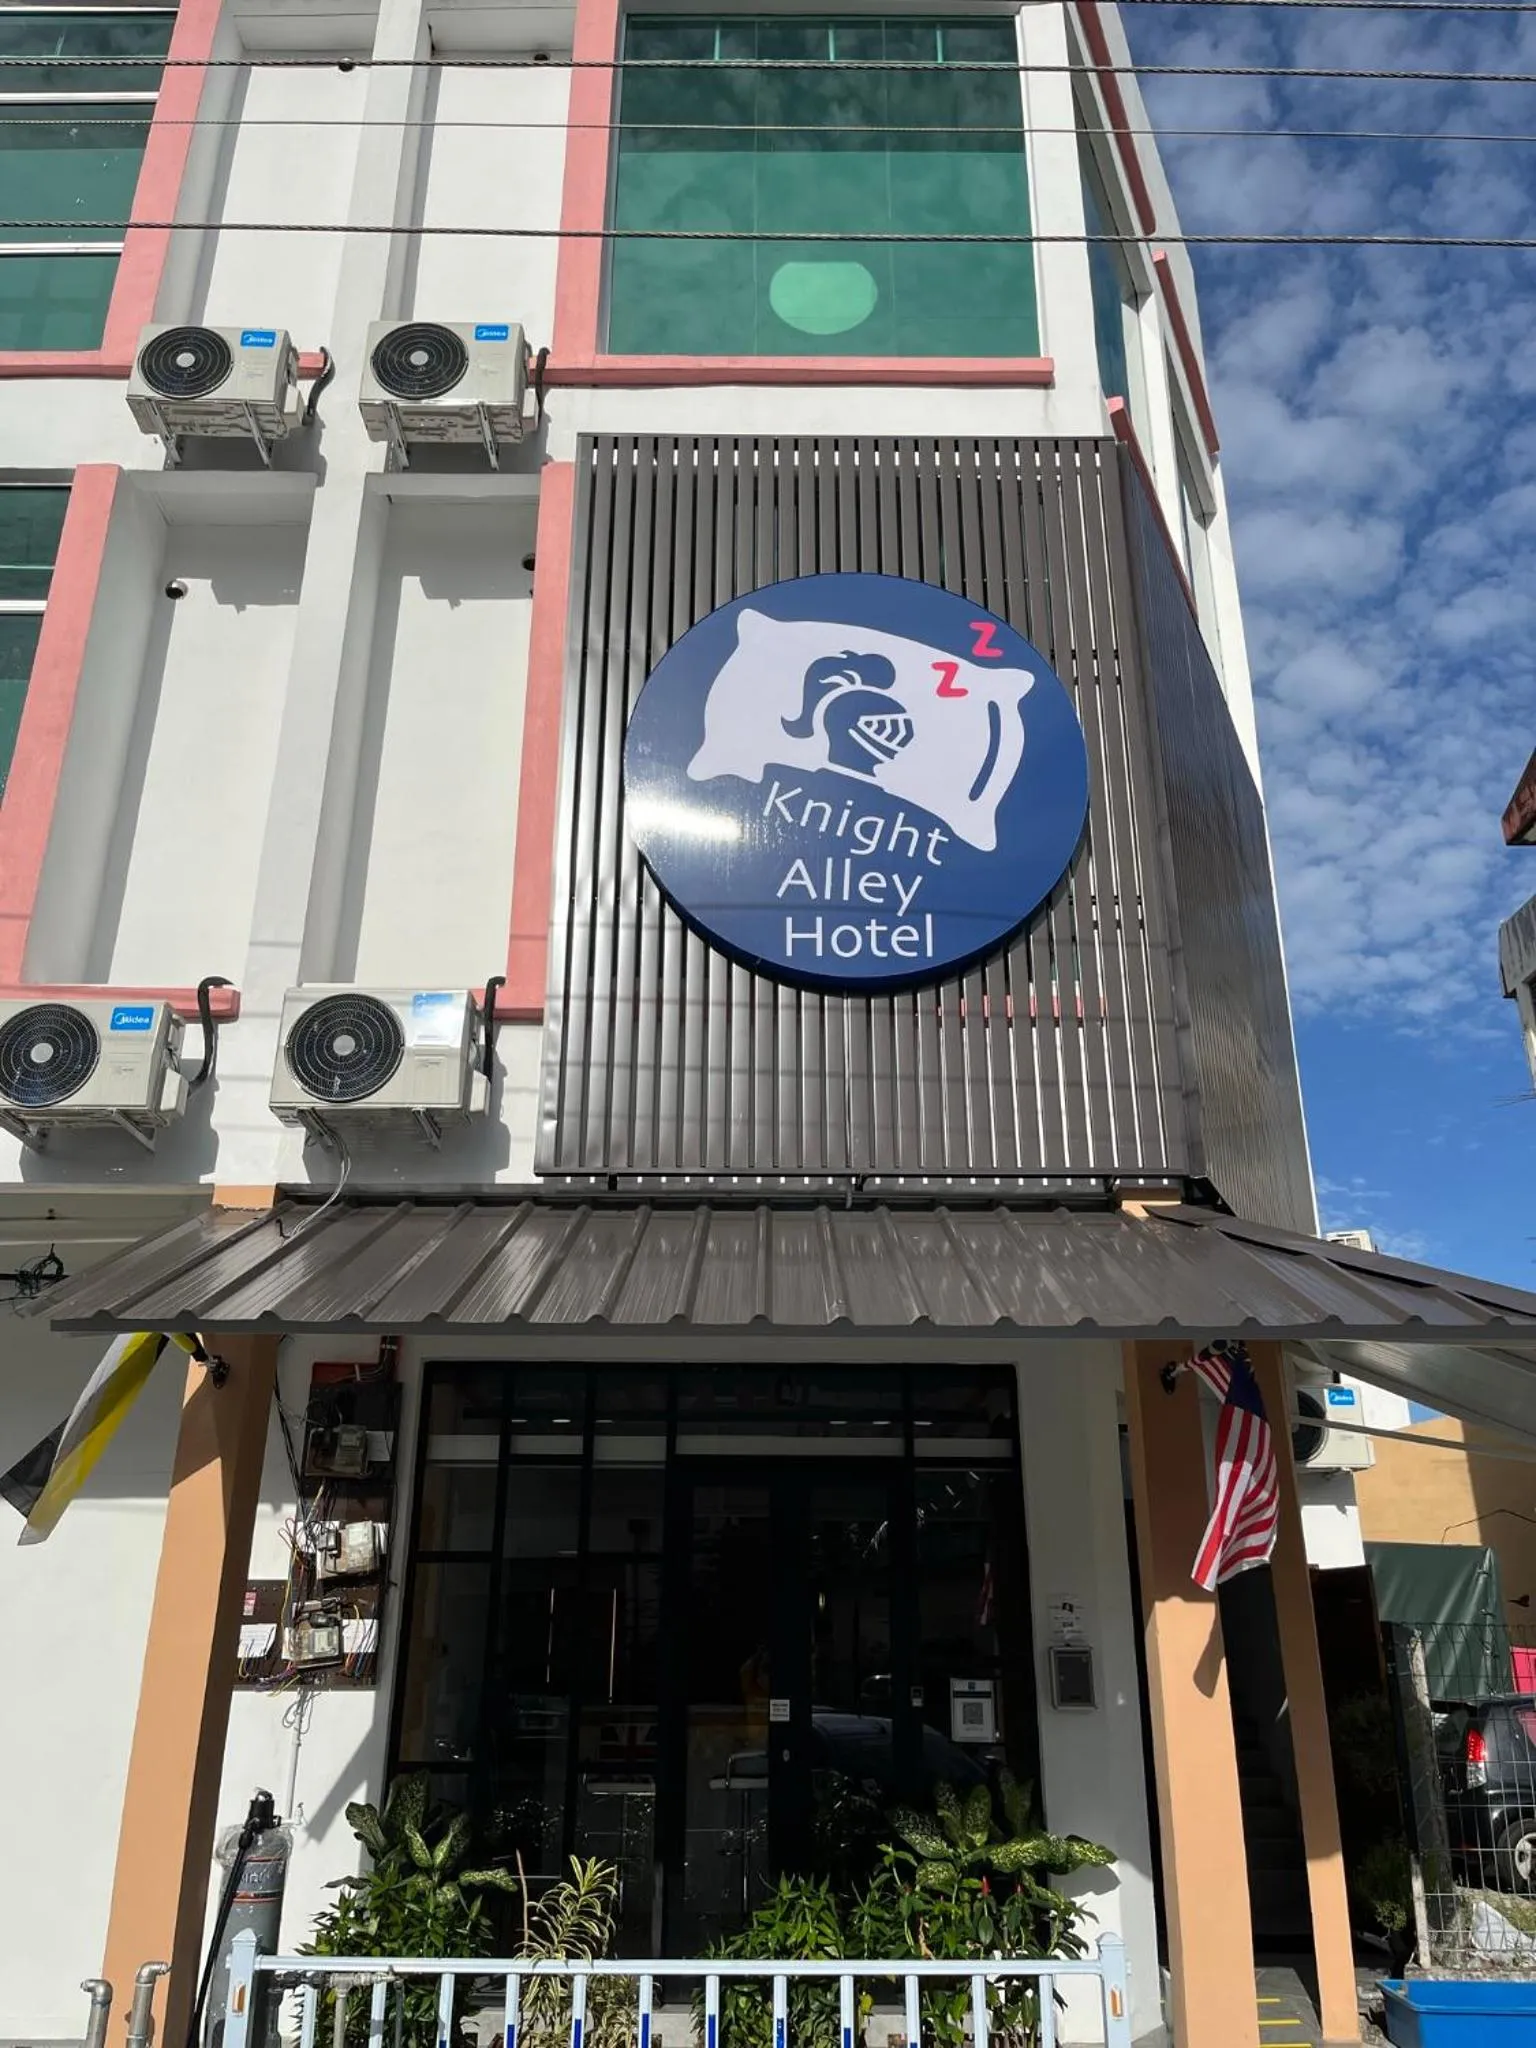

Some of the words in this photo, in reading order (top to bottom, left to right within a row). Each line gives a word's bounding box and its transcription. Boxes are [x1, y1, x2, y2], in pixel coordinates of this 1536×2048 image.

[762, 781, 949, 866] Knight
[776, 857, 923, 917] Alley
[786, 913, 933, 957] Hotel
[115, 1013, 149, 1024] Midea
